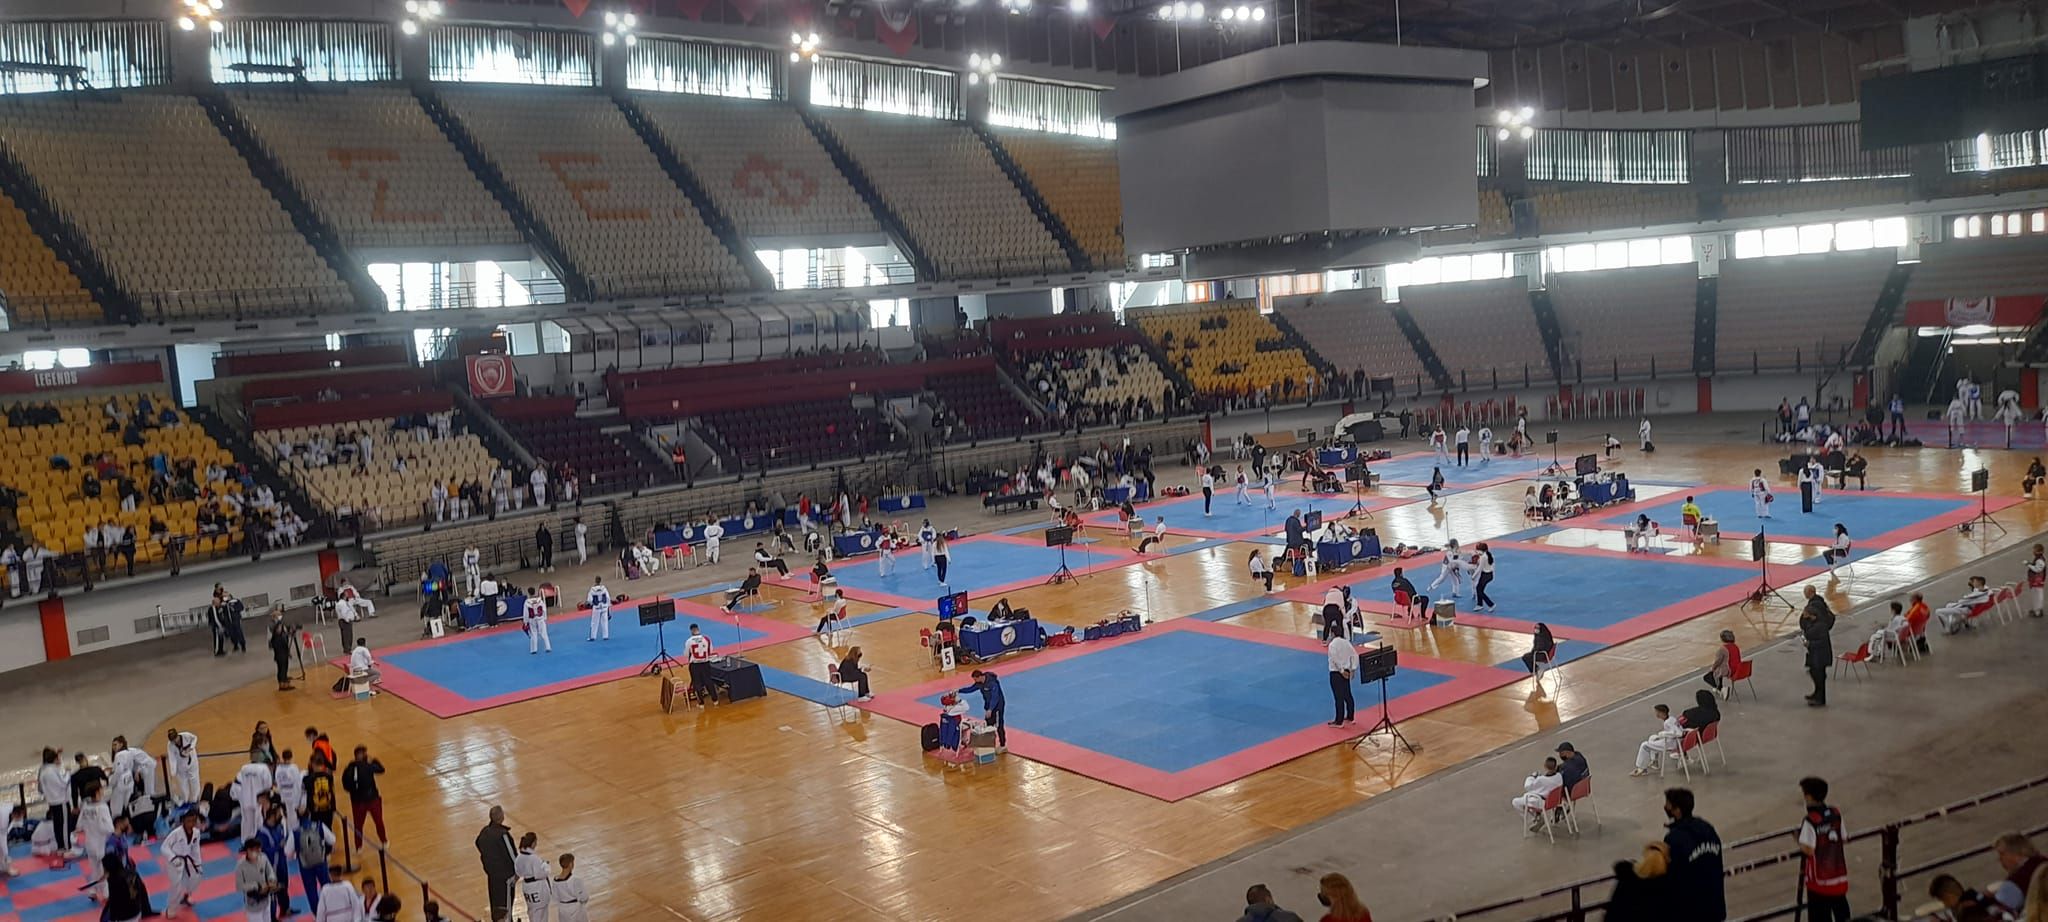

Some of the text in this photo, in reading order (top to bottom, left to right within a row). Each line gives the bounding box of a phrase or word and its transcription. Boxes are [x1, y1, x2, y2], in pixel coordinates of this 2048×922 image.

[34, 371, 78, 387] LEGENDS
[1308, 561, 1313, 572] 6
[945, 651, 951, 665] 5
